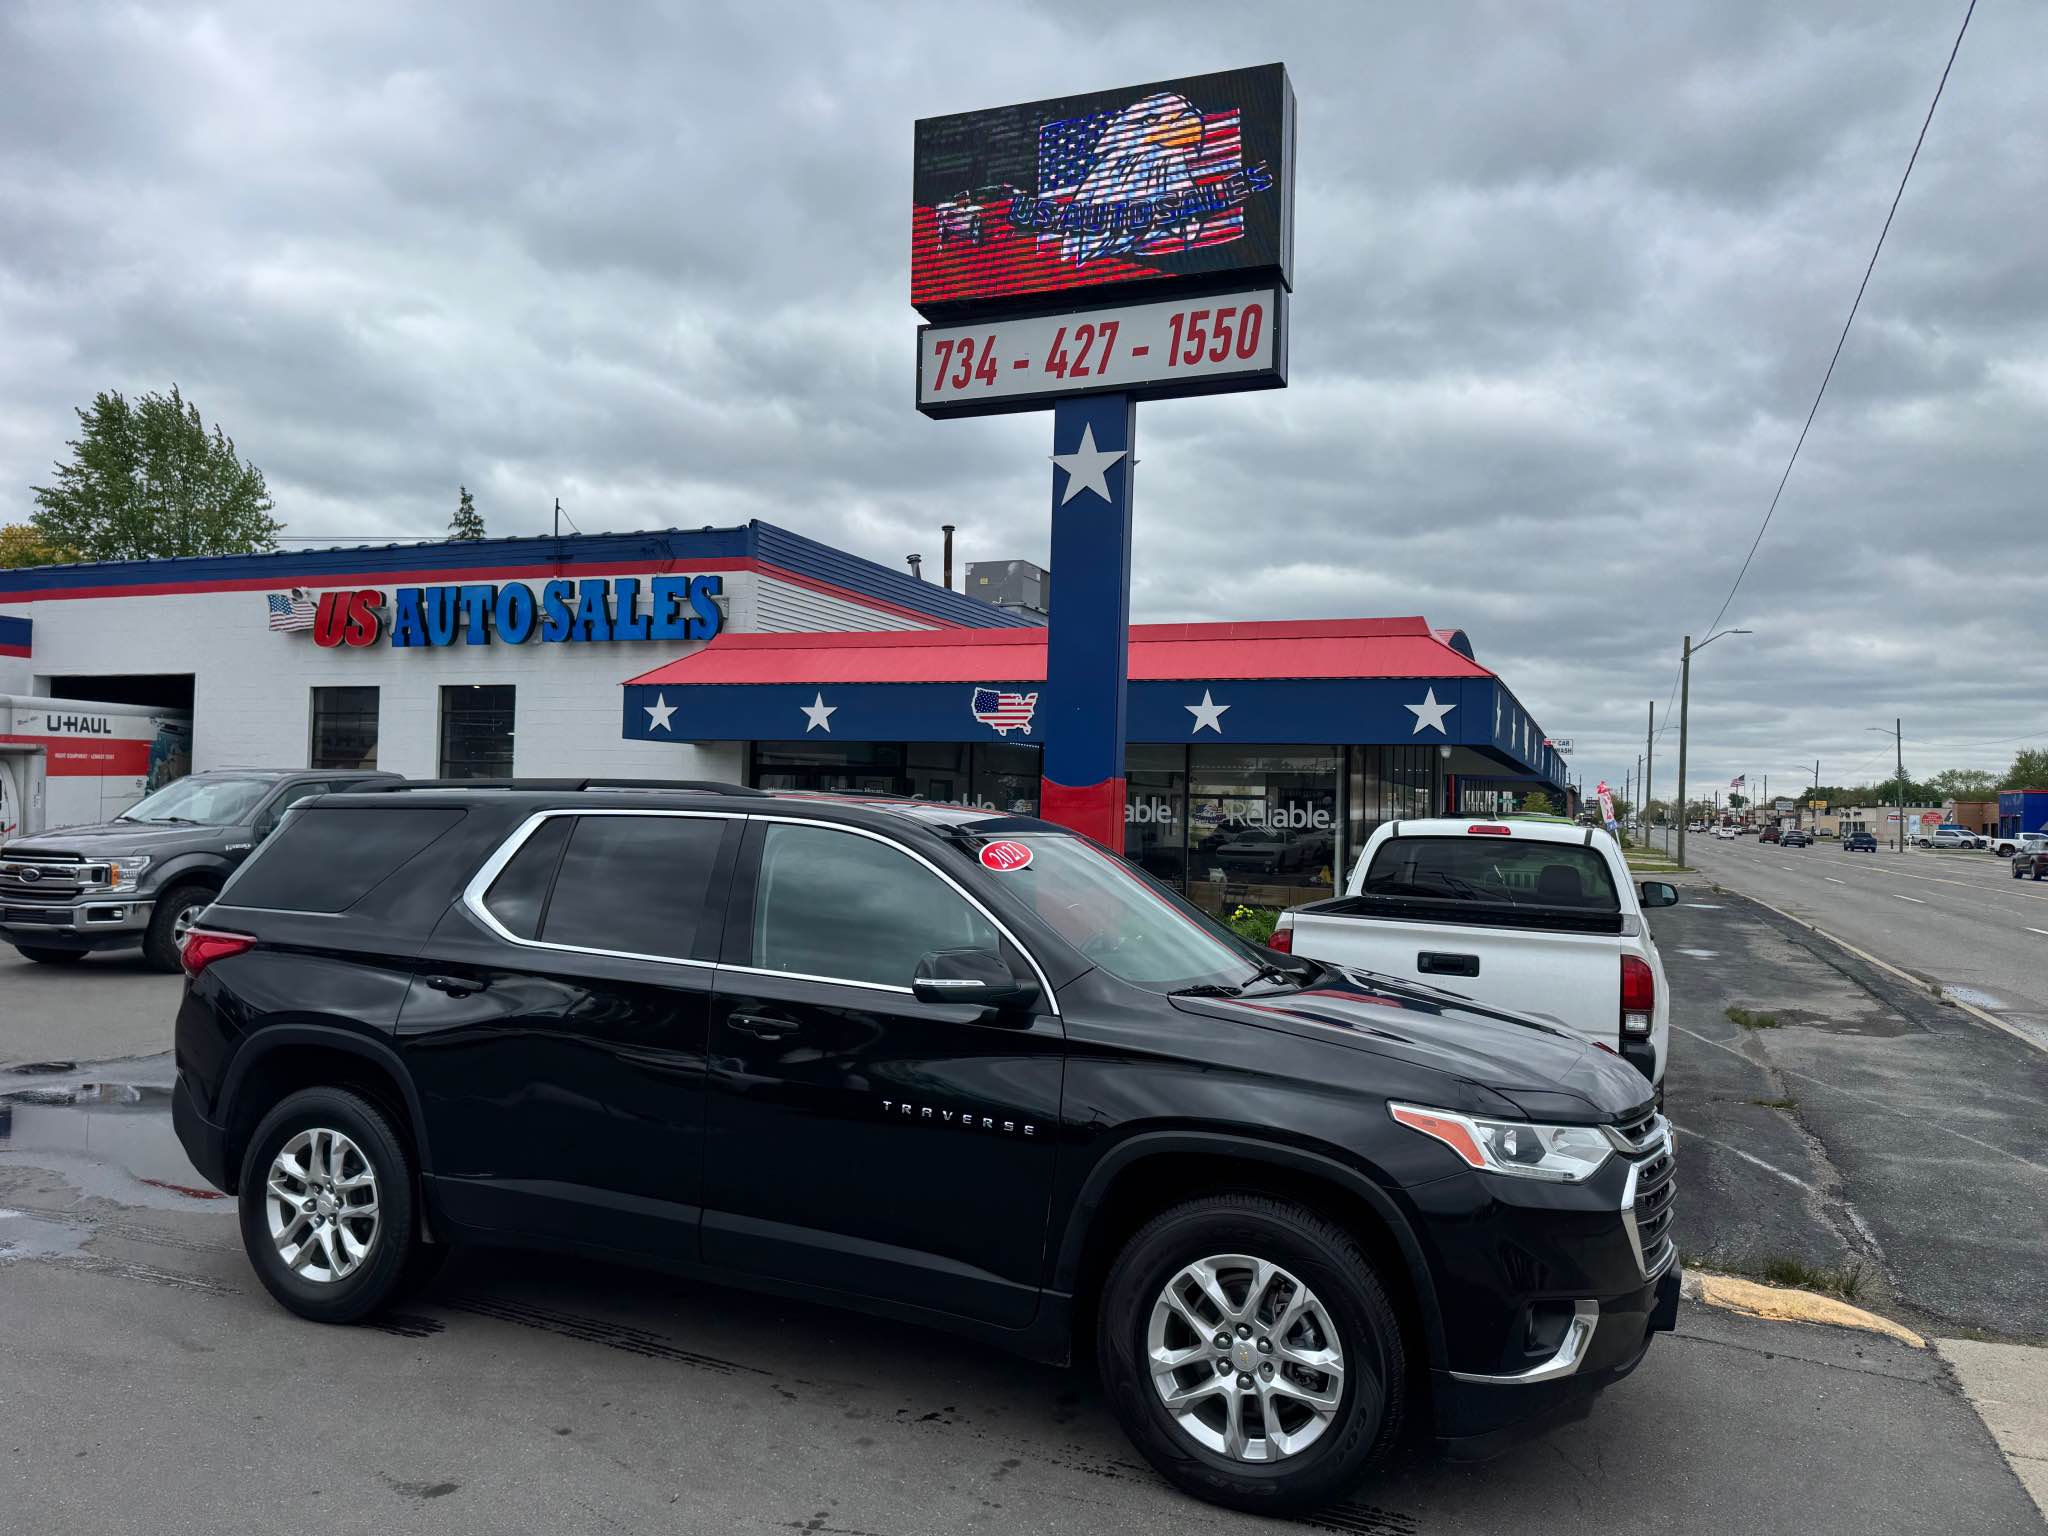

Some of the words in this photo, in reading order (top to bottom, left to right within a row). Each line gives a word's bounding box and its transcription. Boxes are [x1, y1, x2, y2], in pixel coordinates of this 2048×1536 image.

[934, 335, 997, 391] 734
[1044, 320, 1120, 379] 427
[1168, 303, 1263, 367] 1550
[313, 590, 386, 648] US
[391, 582, 539, 648] AUTO
[543, 575, 724, 644] SALES
[46, 714, 112, 735] U-HAUL
[1229, 800, 1337, 829] Reliable.
[988, 842, 1026, 869] 2021
[882, 1100, 1035, 1136] TRAVERSE
